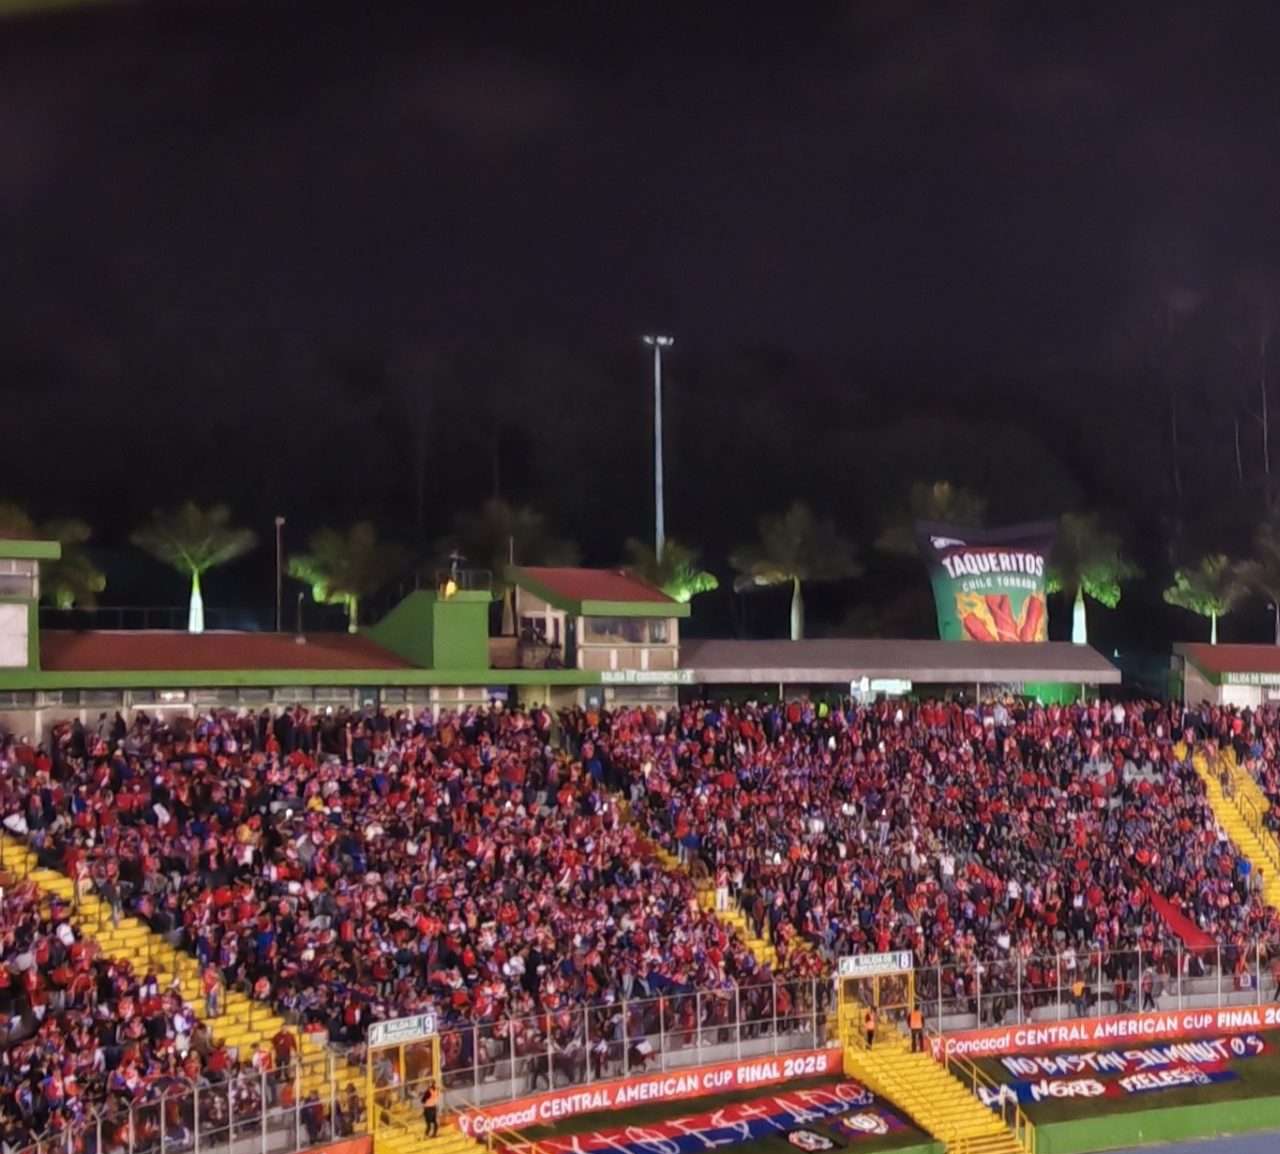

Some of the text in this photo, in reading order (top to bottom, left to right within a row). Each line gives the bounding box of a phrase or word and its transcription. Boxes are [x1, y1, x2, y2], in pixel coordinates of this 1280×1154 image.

[942, 552, 1044, 579] TAQUERITOS
[962, 577, 992, 592] CHILE
[946, 1033, 1011, 1054] Concacaf
[1015, 1024, 1088, 1046] CENTRAL
[1094, 1015, 1179, 1037] AMERICAN
[1182, 1014, 1213, 1030] CUP
[1217, 1010, 1261, 1027] FINAL
[473, 1054, 827, 1133] Concacaf CENTRAL AMERICAN CUP FINAL 2025
